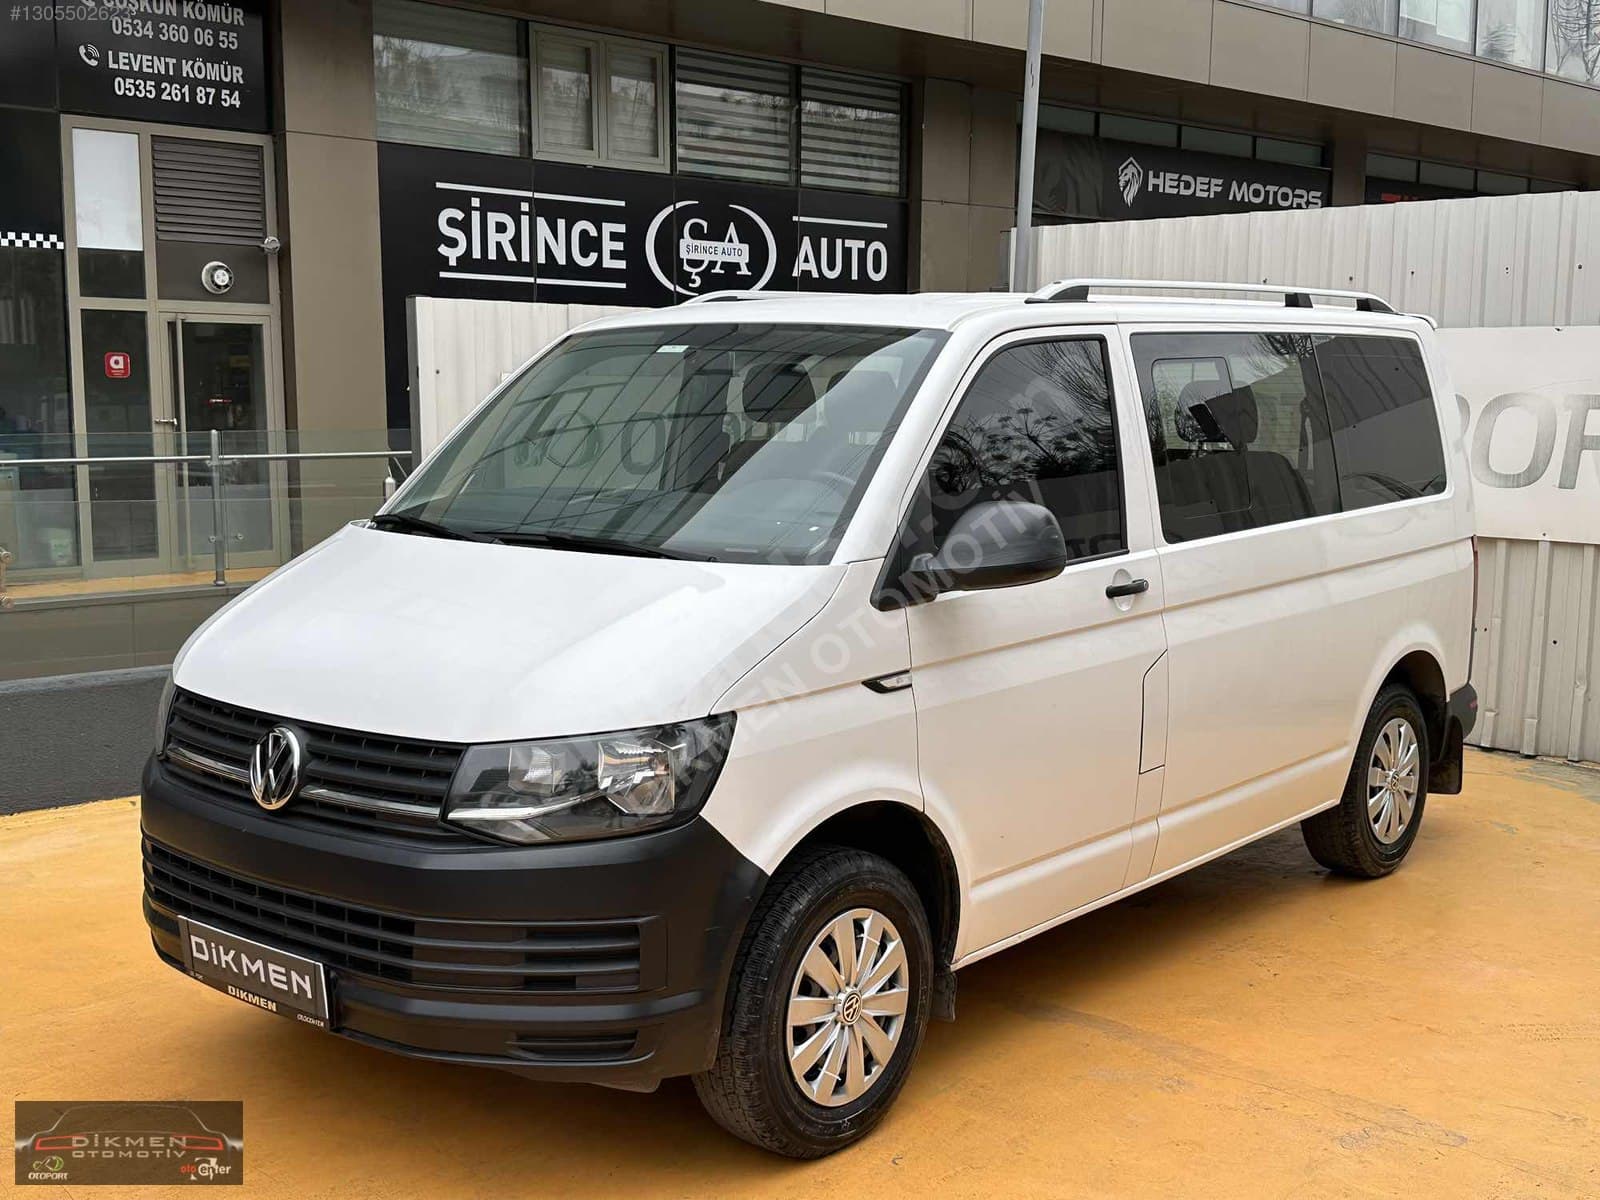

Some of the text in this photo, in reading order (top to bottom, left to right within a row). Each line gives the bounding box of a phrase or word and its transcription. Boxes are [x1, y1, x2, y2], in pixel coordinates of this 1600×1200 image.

[183, 0, 244, 26] KÖMÜR
[112, 16, 238, 49] 0534 360 06 55
[108, 51, 244, 84] LEVENT KÖMÜR
[114, 77, 240, 108] 0535 261 87 54
[1147, 170, 1322, 209] HEDEF MOTORS
[437, 197, 888, 282] ŞİRİNCE AUTO
[685, 243, 743, 257] ŞİRİNCE AUTO
